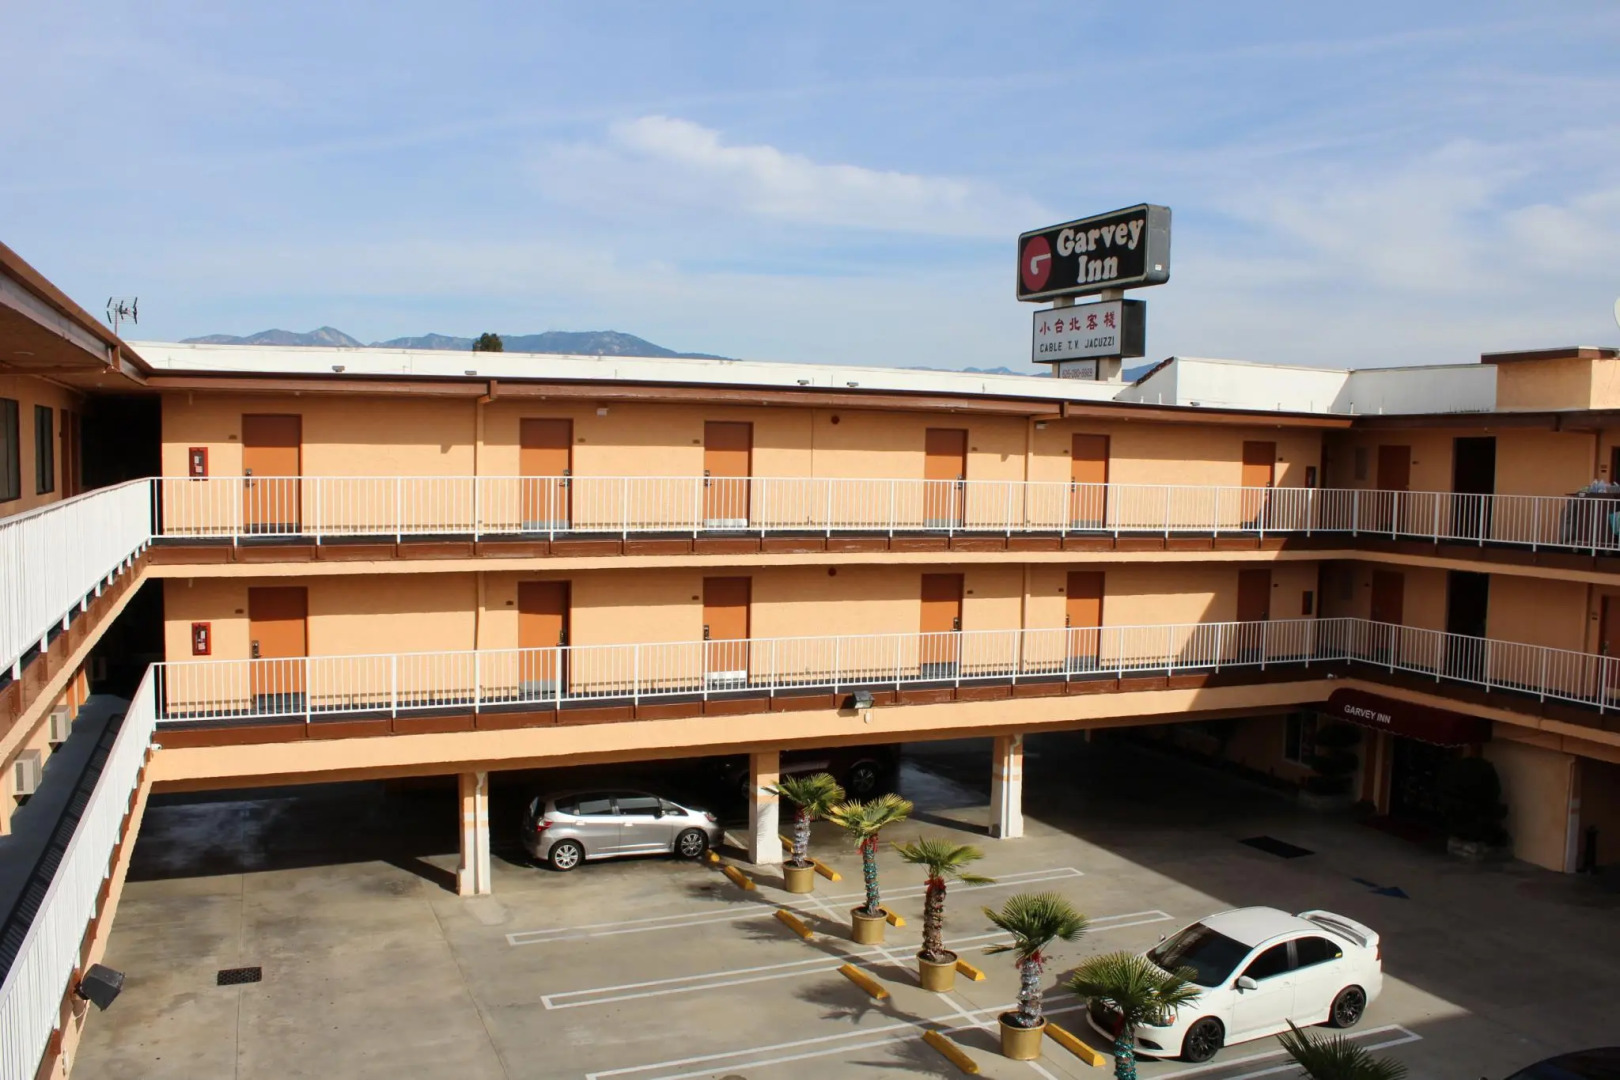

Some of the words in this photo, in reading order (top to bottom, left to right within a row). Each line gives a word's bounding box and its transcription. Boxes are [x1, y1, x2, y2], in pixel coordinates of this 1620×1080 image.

[1057, 219, 1144, 257] Garvey
[1077, 255, 1118, 284] Inn
[1040, 342, 1063, 353] CABLE
[1085, 335, 1115, 349] JACUZZI
[1344, 704, 1376, 720] GARVEY
[1377, 713, 1391, 724] INN
